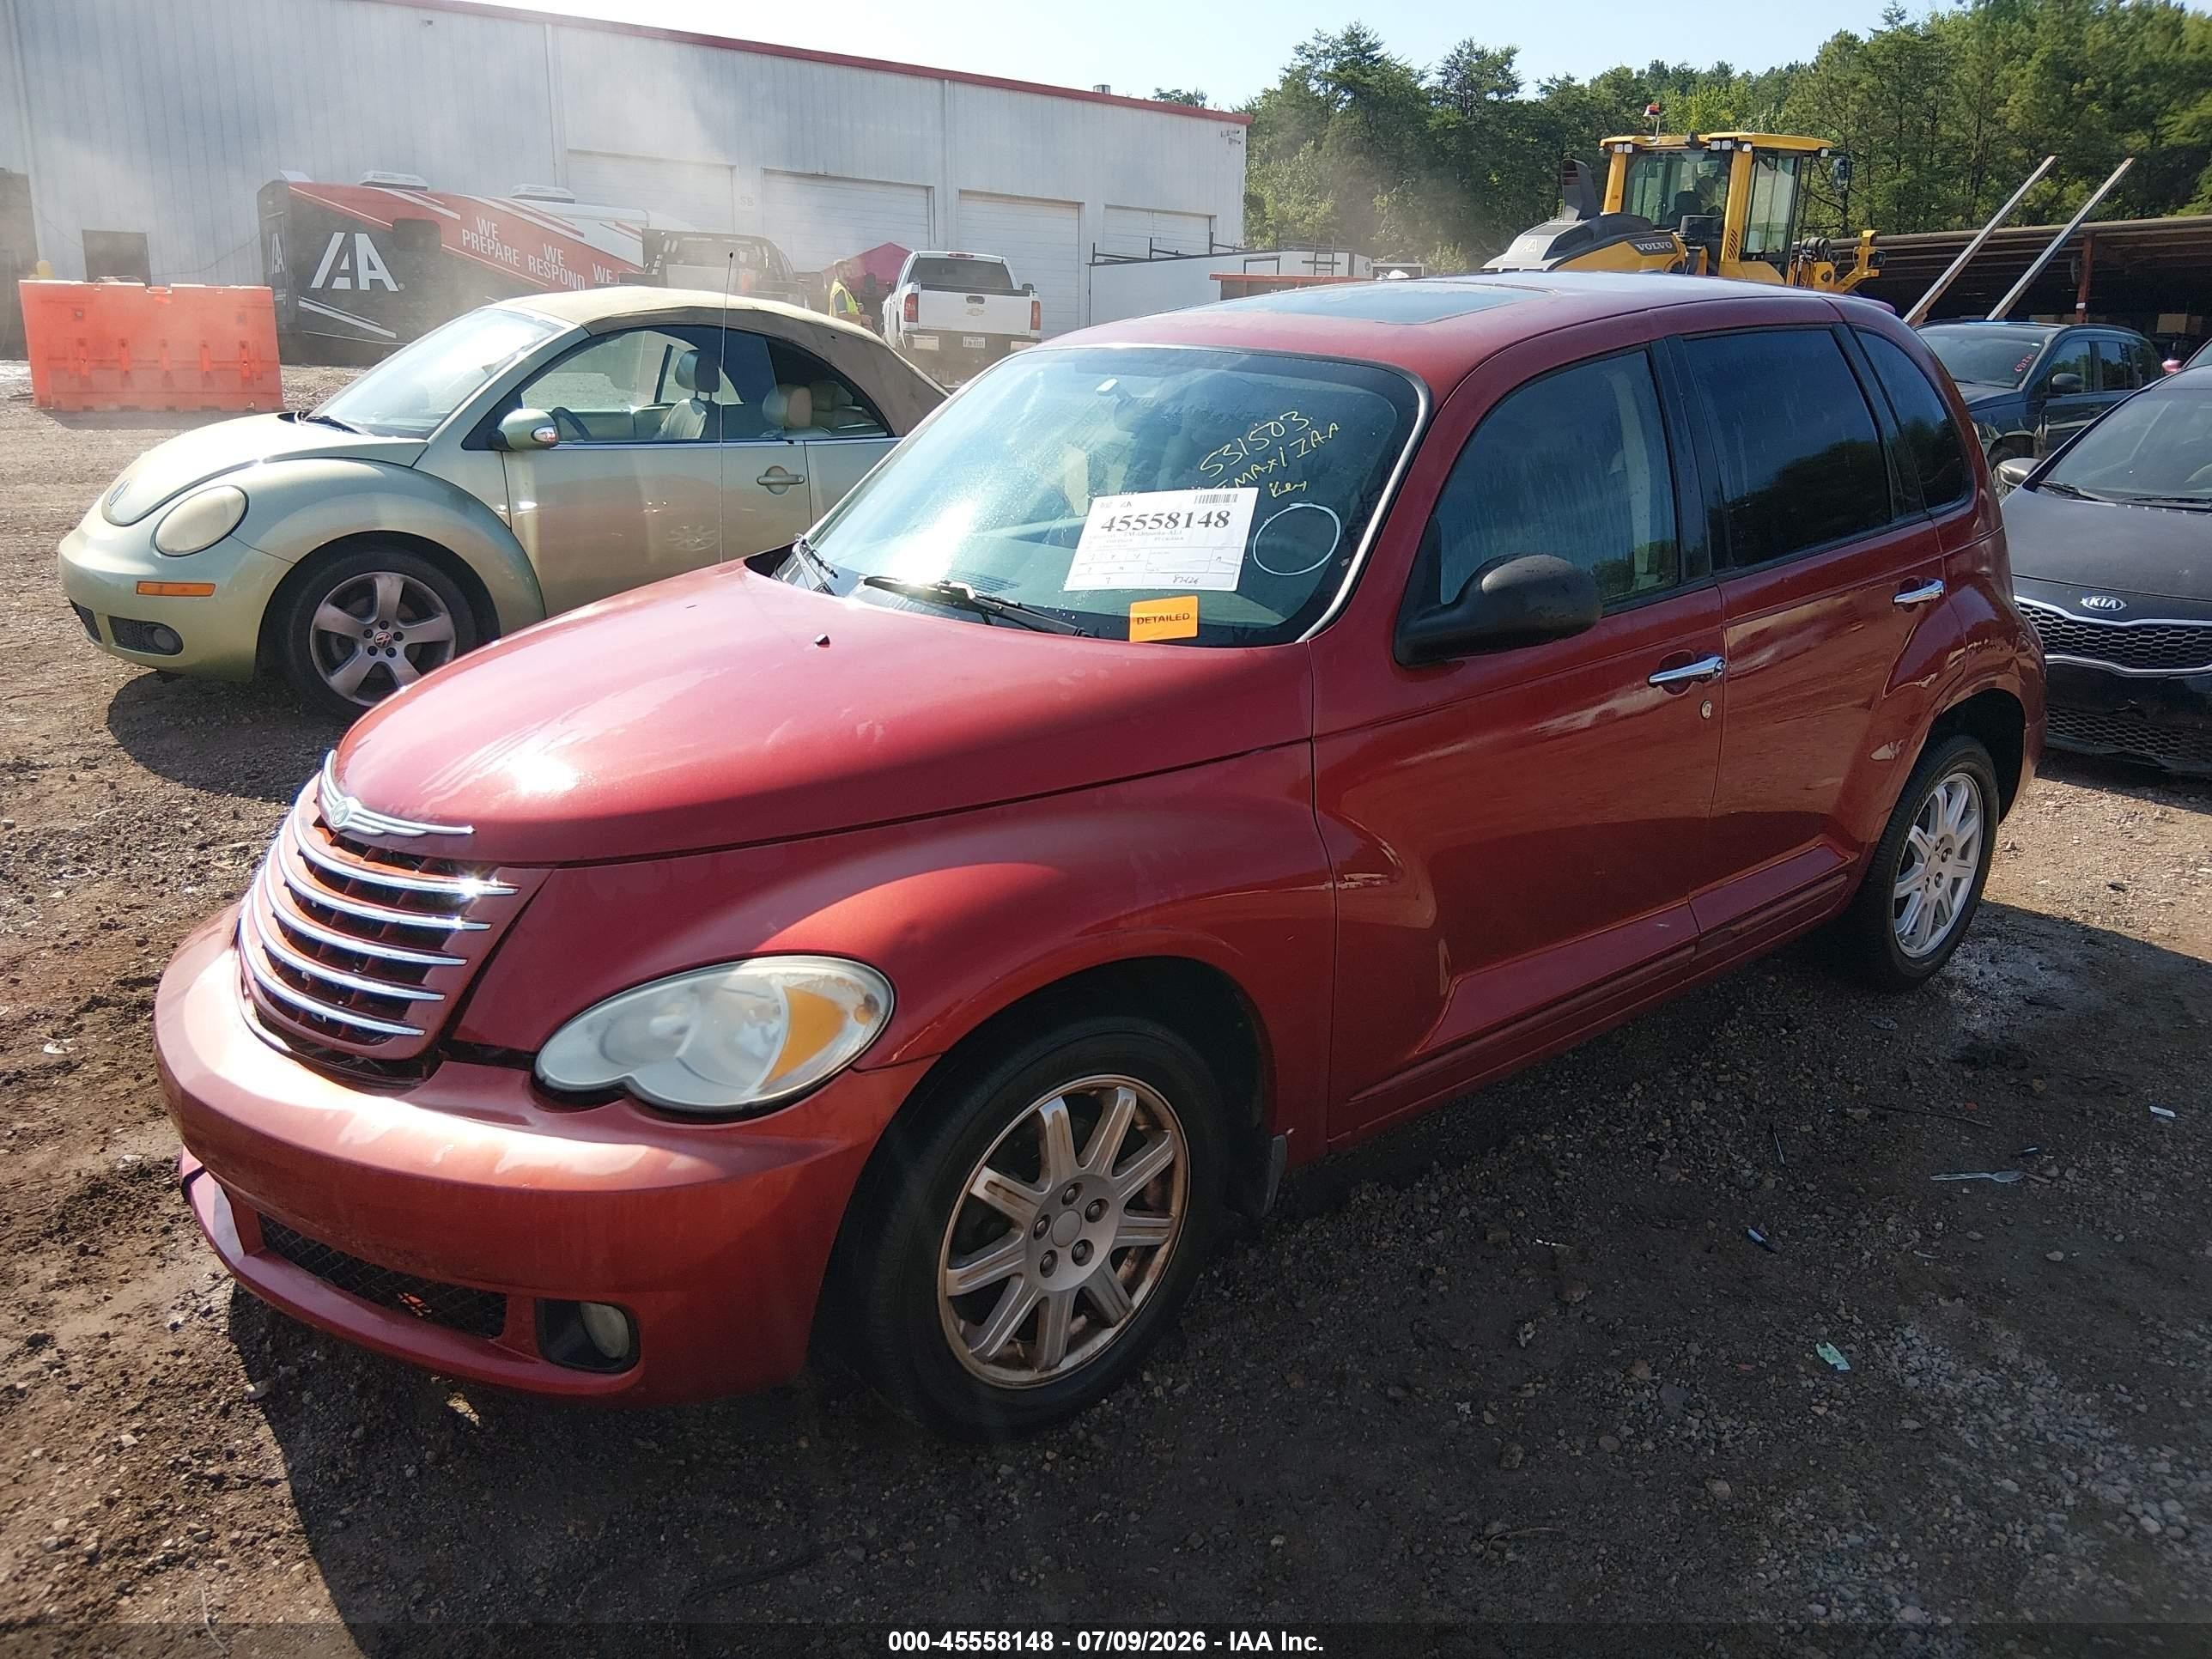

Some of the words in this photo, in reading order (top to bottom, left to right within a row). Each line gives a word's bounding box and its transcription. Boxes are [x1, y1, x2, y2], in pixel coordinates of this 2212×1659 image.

[476, 216, 499, 241] WE
[462, 229, 521, 267] PREPARE
[544, 243, 564, 267] WE
[1635, 241, 1673, 251] VOLVO
[528, 254, 586, 290] RESPOND
[1200, 411, 1310, 478] 531503
[1101, 510, 1231, 532] 45558148
[2088, 597, 2117, 609] KIA
[1136, 612, 1190, 625] DETAILED
